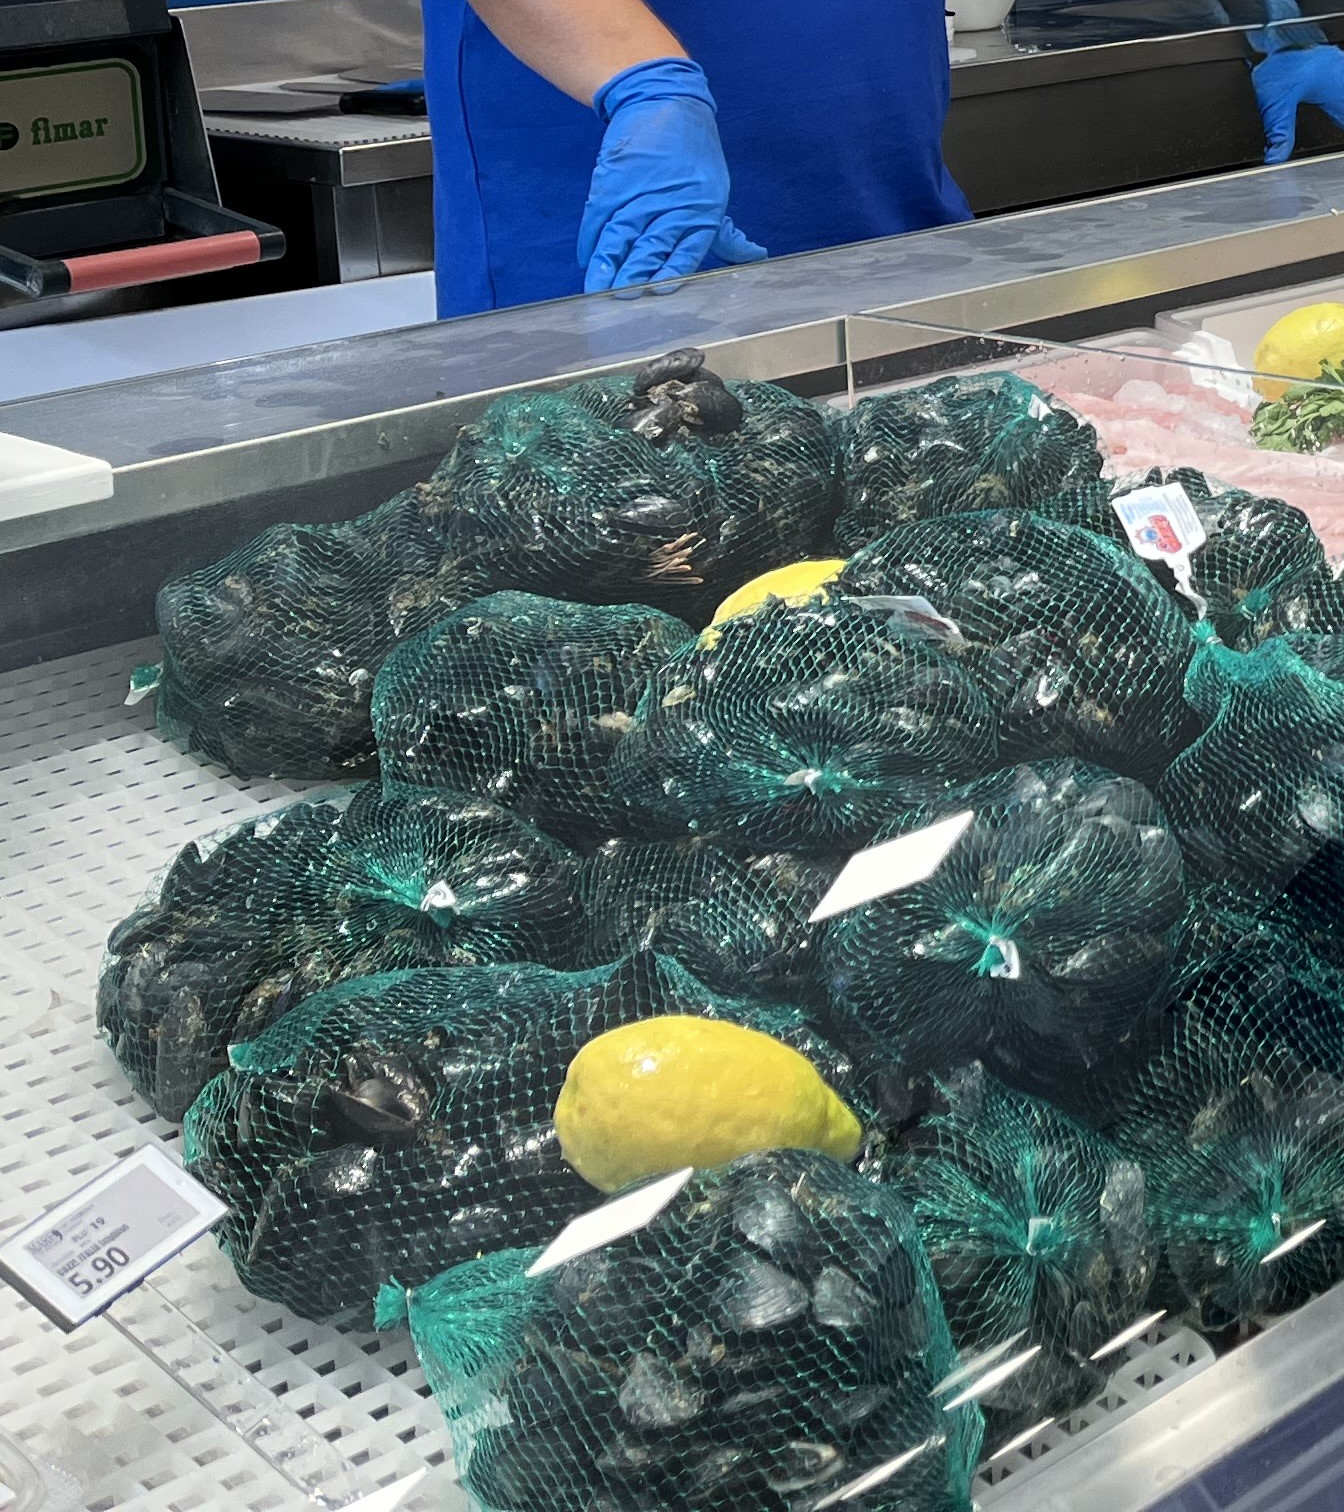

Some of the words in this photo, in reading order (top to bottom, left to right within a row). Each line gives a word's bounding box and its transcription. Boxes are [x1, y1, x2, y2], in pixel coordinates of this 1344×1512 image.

[30, 117, 108, 145] fimar
[89, 1216, 105, 1230] 19
[68, 1246, 130, 1295] 5.90
